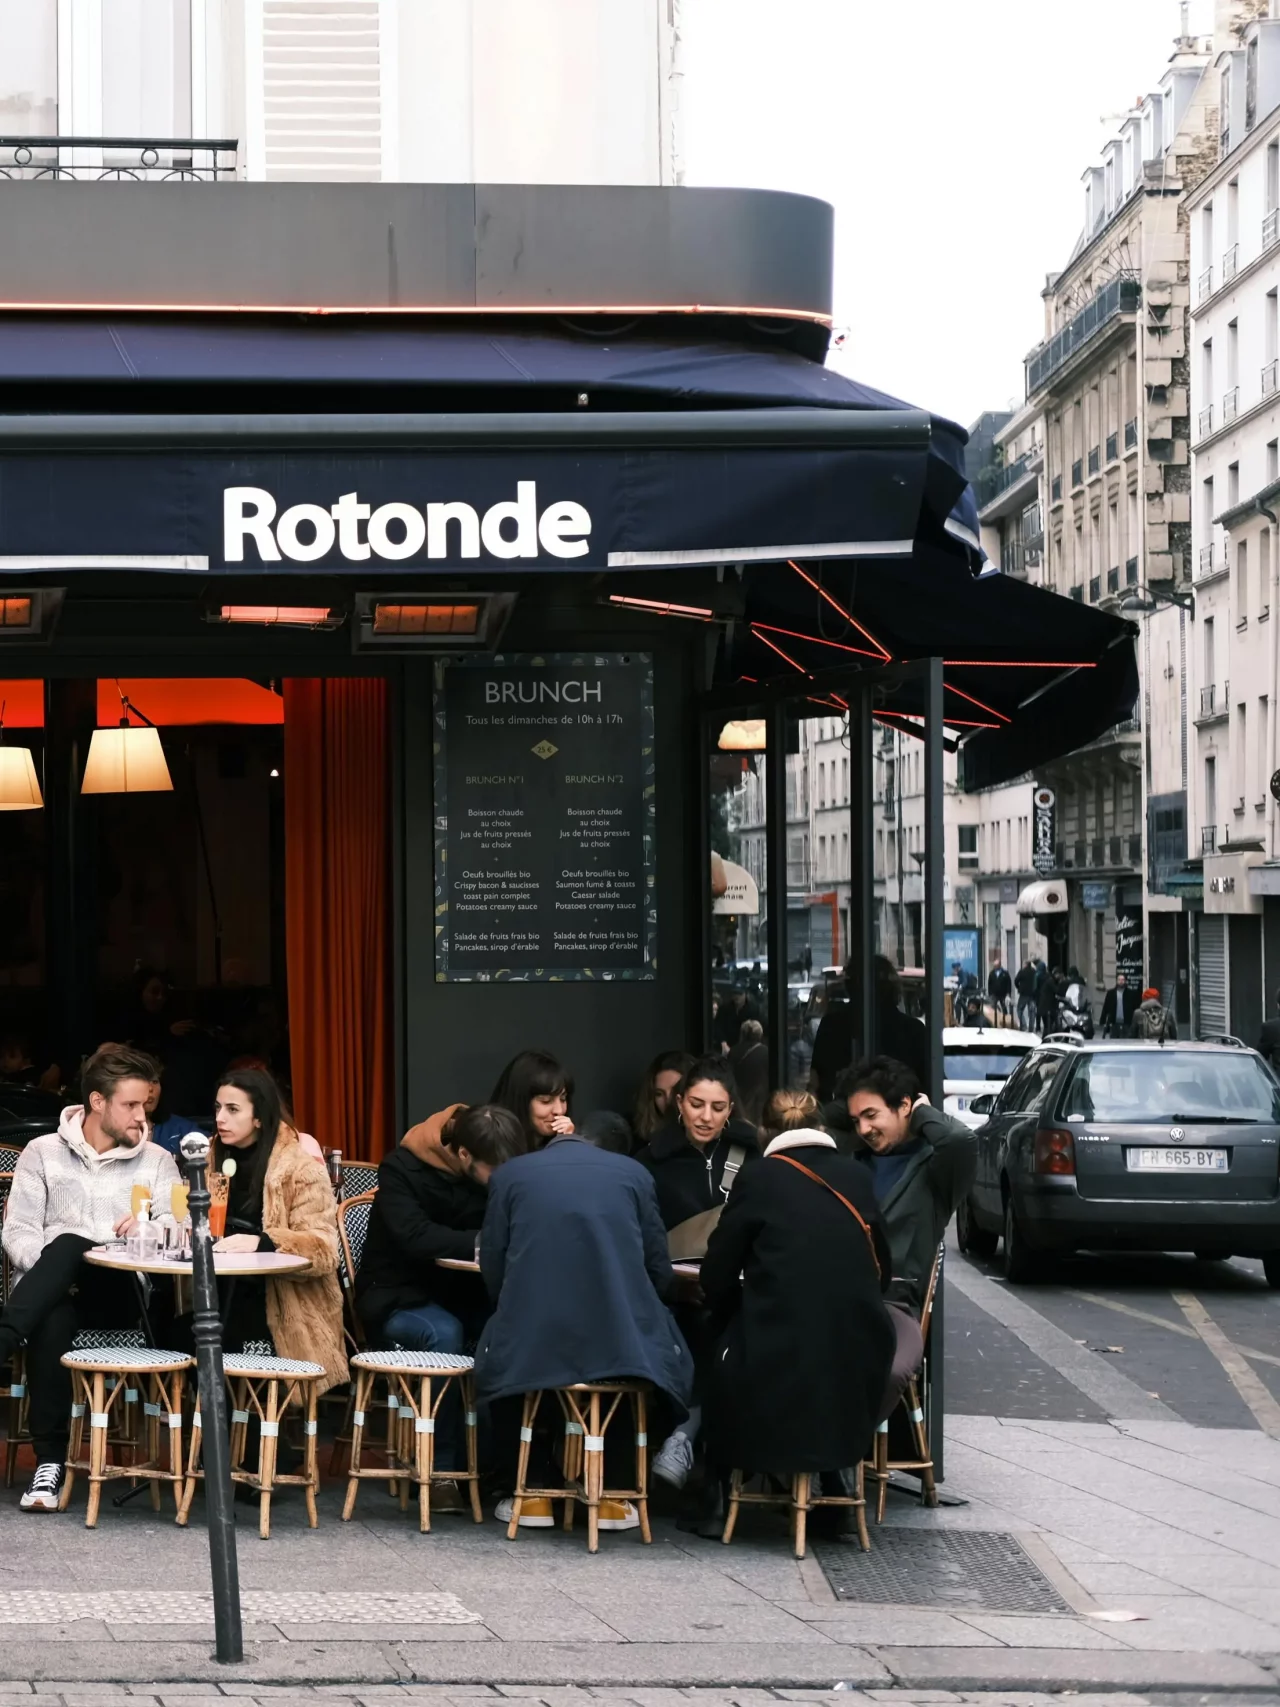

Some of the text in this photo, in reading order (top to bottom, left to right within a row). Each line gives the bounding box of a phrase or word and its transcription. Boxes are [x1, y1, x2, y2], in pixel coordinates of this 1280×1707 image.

[224, 481, 592, 562] Rotonde
[486, 681, 602, 703] BRUNCH
[466, 714, 623, 724] Tous les dimanches de 10h à 17h
[466, 776, 506, 784] BRUNCH
[565, 775, 605, 784] BRUNCH
[468, 808, 496, 816] Boisson
[567, 808, 622, 816] Boisson chaude
[460, 831, 471, 840] Jus
[472, 830, 482, 838] de
[484, 830, 503, 838] fruits
[559, 830, 570, 839] Jus
[572, 829, 582, 837] de
[583, 829, 602, 837] fruits
[590, 840, 610, 848] choix
[462, 870, 484, 878] Oeufs
[519, 870, 531, 878] bio
[561, 870, 584, 878] Oeufs
[454, 881, 477, 891] Crispy
[478, 881, 500, 889] bacon
[556, 880, 584, 888] Saumon
[606, 880, 612, 888] &
[483, 893, 499, 902] pain
[500, 892, 530, 901] complet
[571, 890, 596, 899] Caesar
[456, 902, 488, 910] Potatoes
[490, 904, 516, 912] creamy
[555, 902, 587, 910] Potatoes
[454, 932, 540, 940] Salade de fruits frais bio
[553, 932, 576, 940] Salade
[490, 944, 509, 952] sirop
[589, 943, 608, 951] sirop
